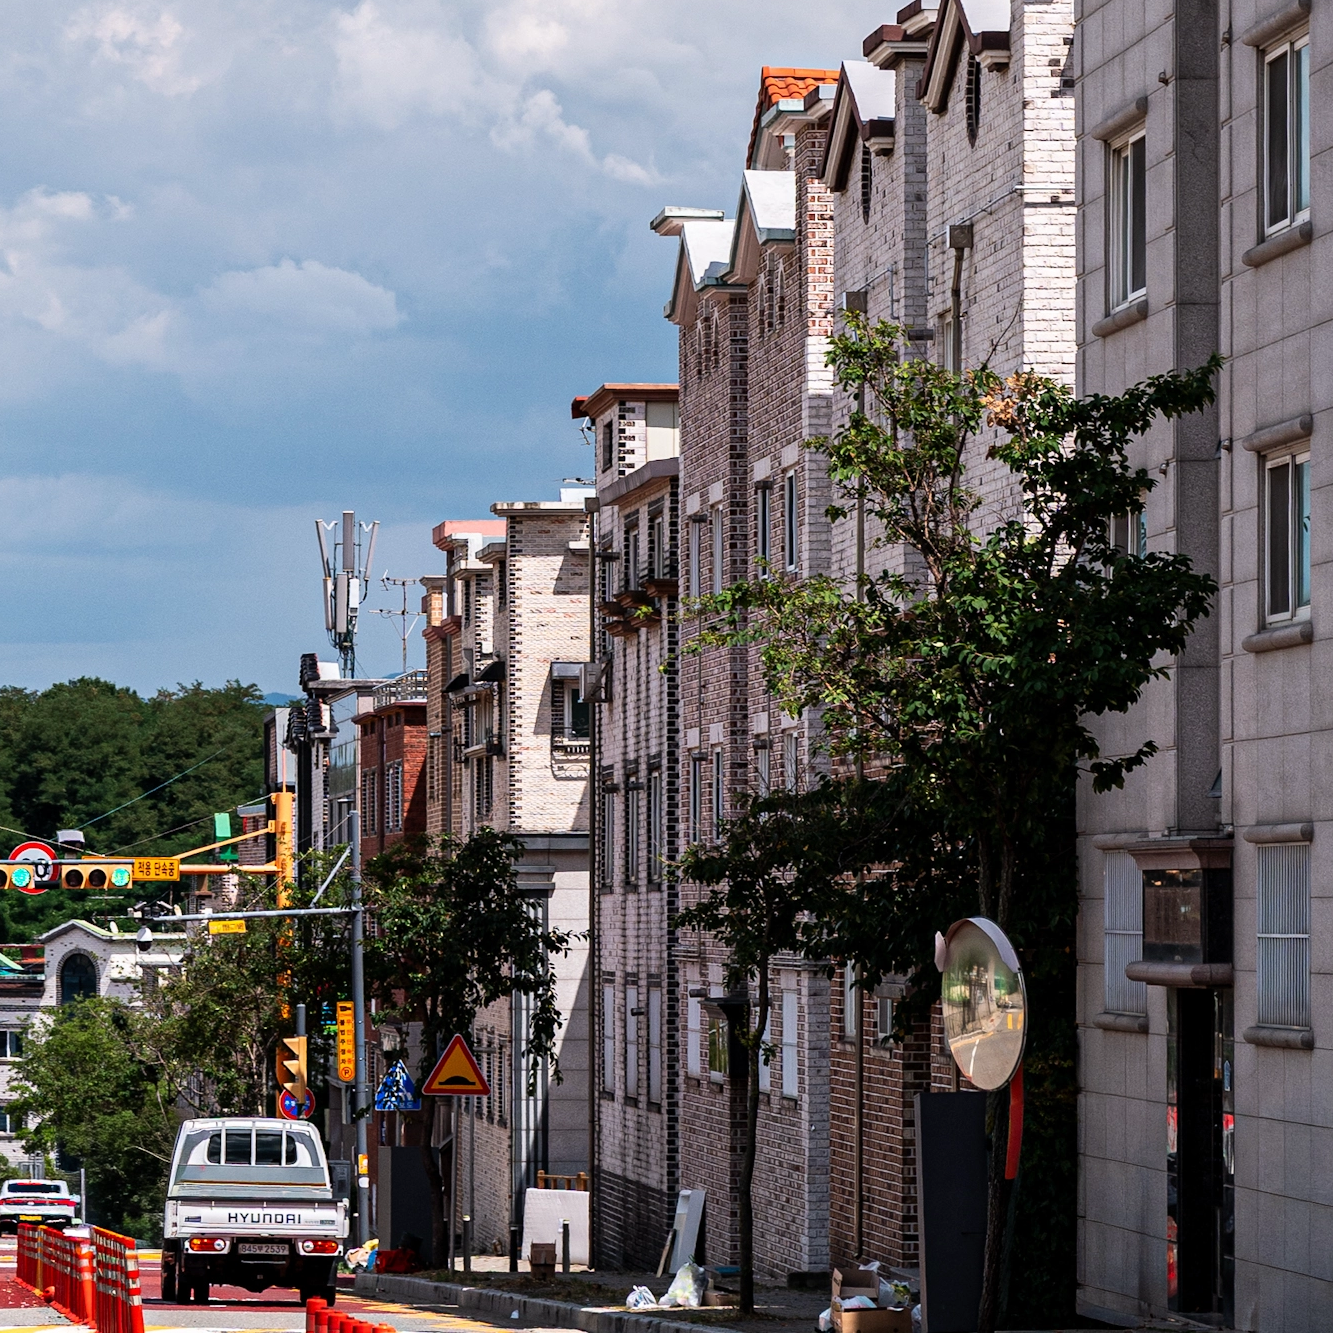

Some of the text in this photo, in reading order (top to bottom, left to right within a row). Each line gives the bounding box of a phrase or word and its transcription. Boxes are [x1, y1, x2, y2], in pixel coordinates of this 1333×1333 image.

[138, 861, 152, 877] 적용
[154, 861, 175, 877] 단속중
[228, 1212, 301, 1224] HYUNDAI
